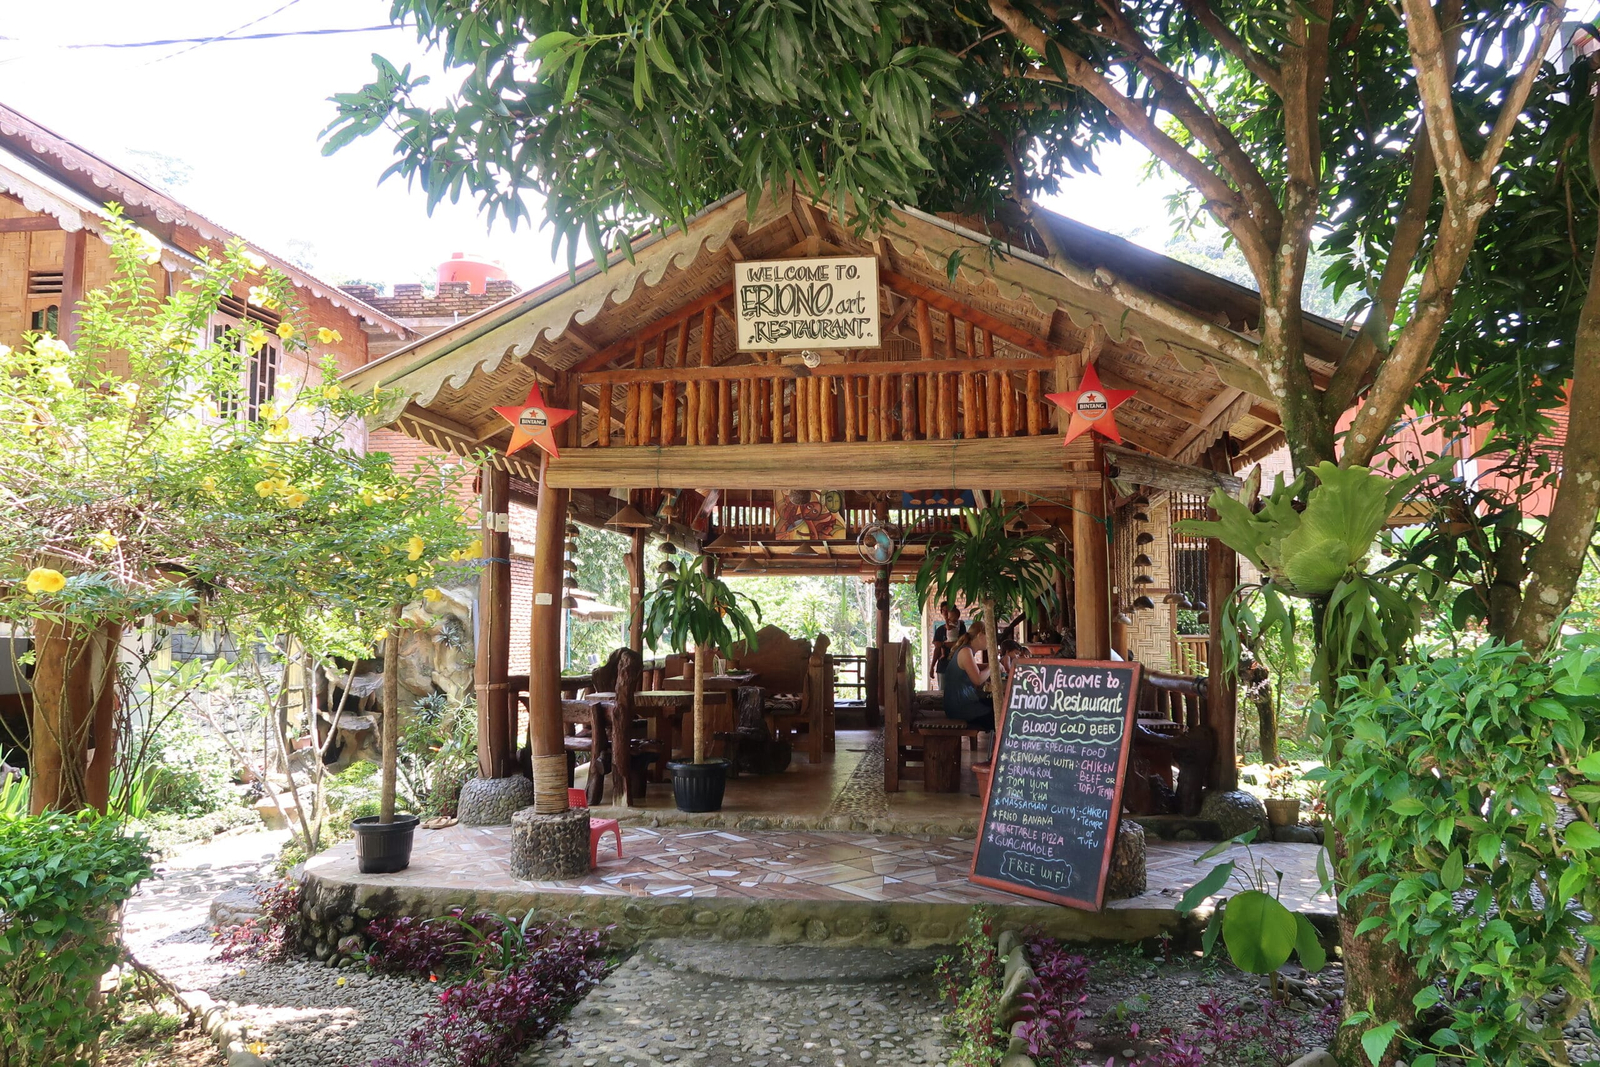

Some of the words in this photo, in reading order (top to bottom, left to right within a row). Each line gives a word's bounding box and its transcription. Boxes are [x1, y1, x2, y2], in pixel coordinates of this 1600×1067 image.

[747, 264, 829, 282] WELCOME
[835, 290, 866, 315] art
[1079, 402, 1105, 410] BINTANG
[521, 418, 545, 426] BINTANG
[1107, 671, 1120, 688] to
[1050, 689, 1123, 713] Restaurant
[1022, 720, 1057, 737] BLOODY
[1060, 722, 1086, 735] COLD
[1090, 723, 1116, 736] BEER
[1022, 741, 1041, 751] HAVE
[1045, 741, 1078, 754] SPECIAL
[1010, 750, 1050, 766] RENDANG
[1007, 763, 1035, 777] SPRING
[1079, 770, 1101, 785] BEEF
[1006, 775, 1025, 787] TOM
[1030, 779, 1049, 794] YUM
[1077, 782, 1096, 795] TOFU
[1001, 797, 1048, 811] MASSAMAN
[1032, 792, 1048, 801] KHA
[998, 810, 1018, 822] FRIED
[1022, 814, 1054, 826] BANANA
[996, 822, 1038, 840] VEGETABLE
[1041, 832, 1064, 846] PIZZA
[994, 834, 1054, 857] GUACAMOLE
[1009, 857, 1036, 876] FREE
